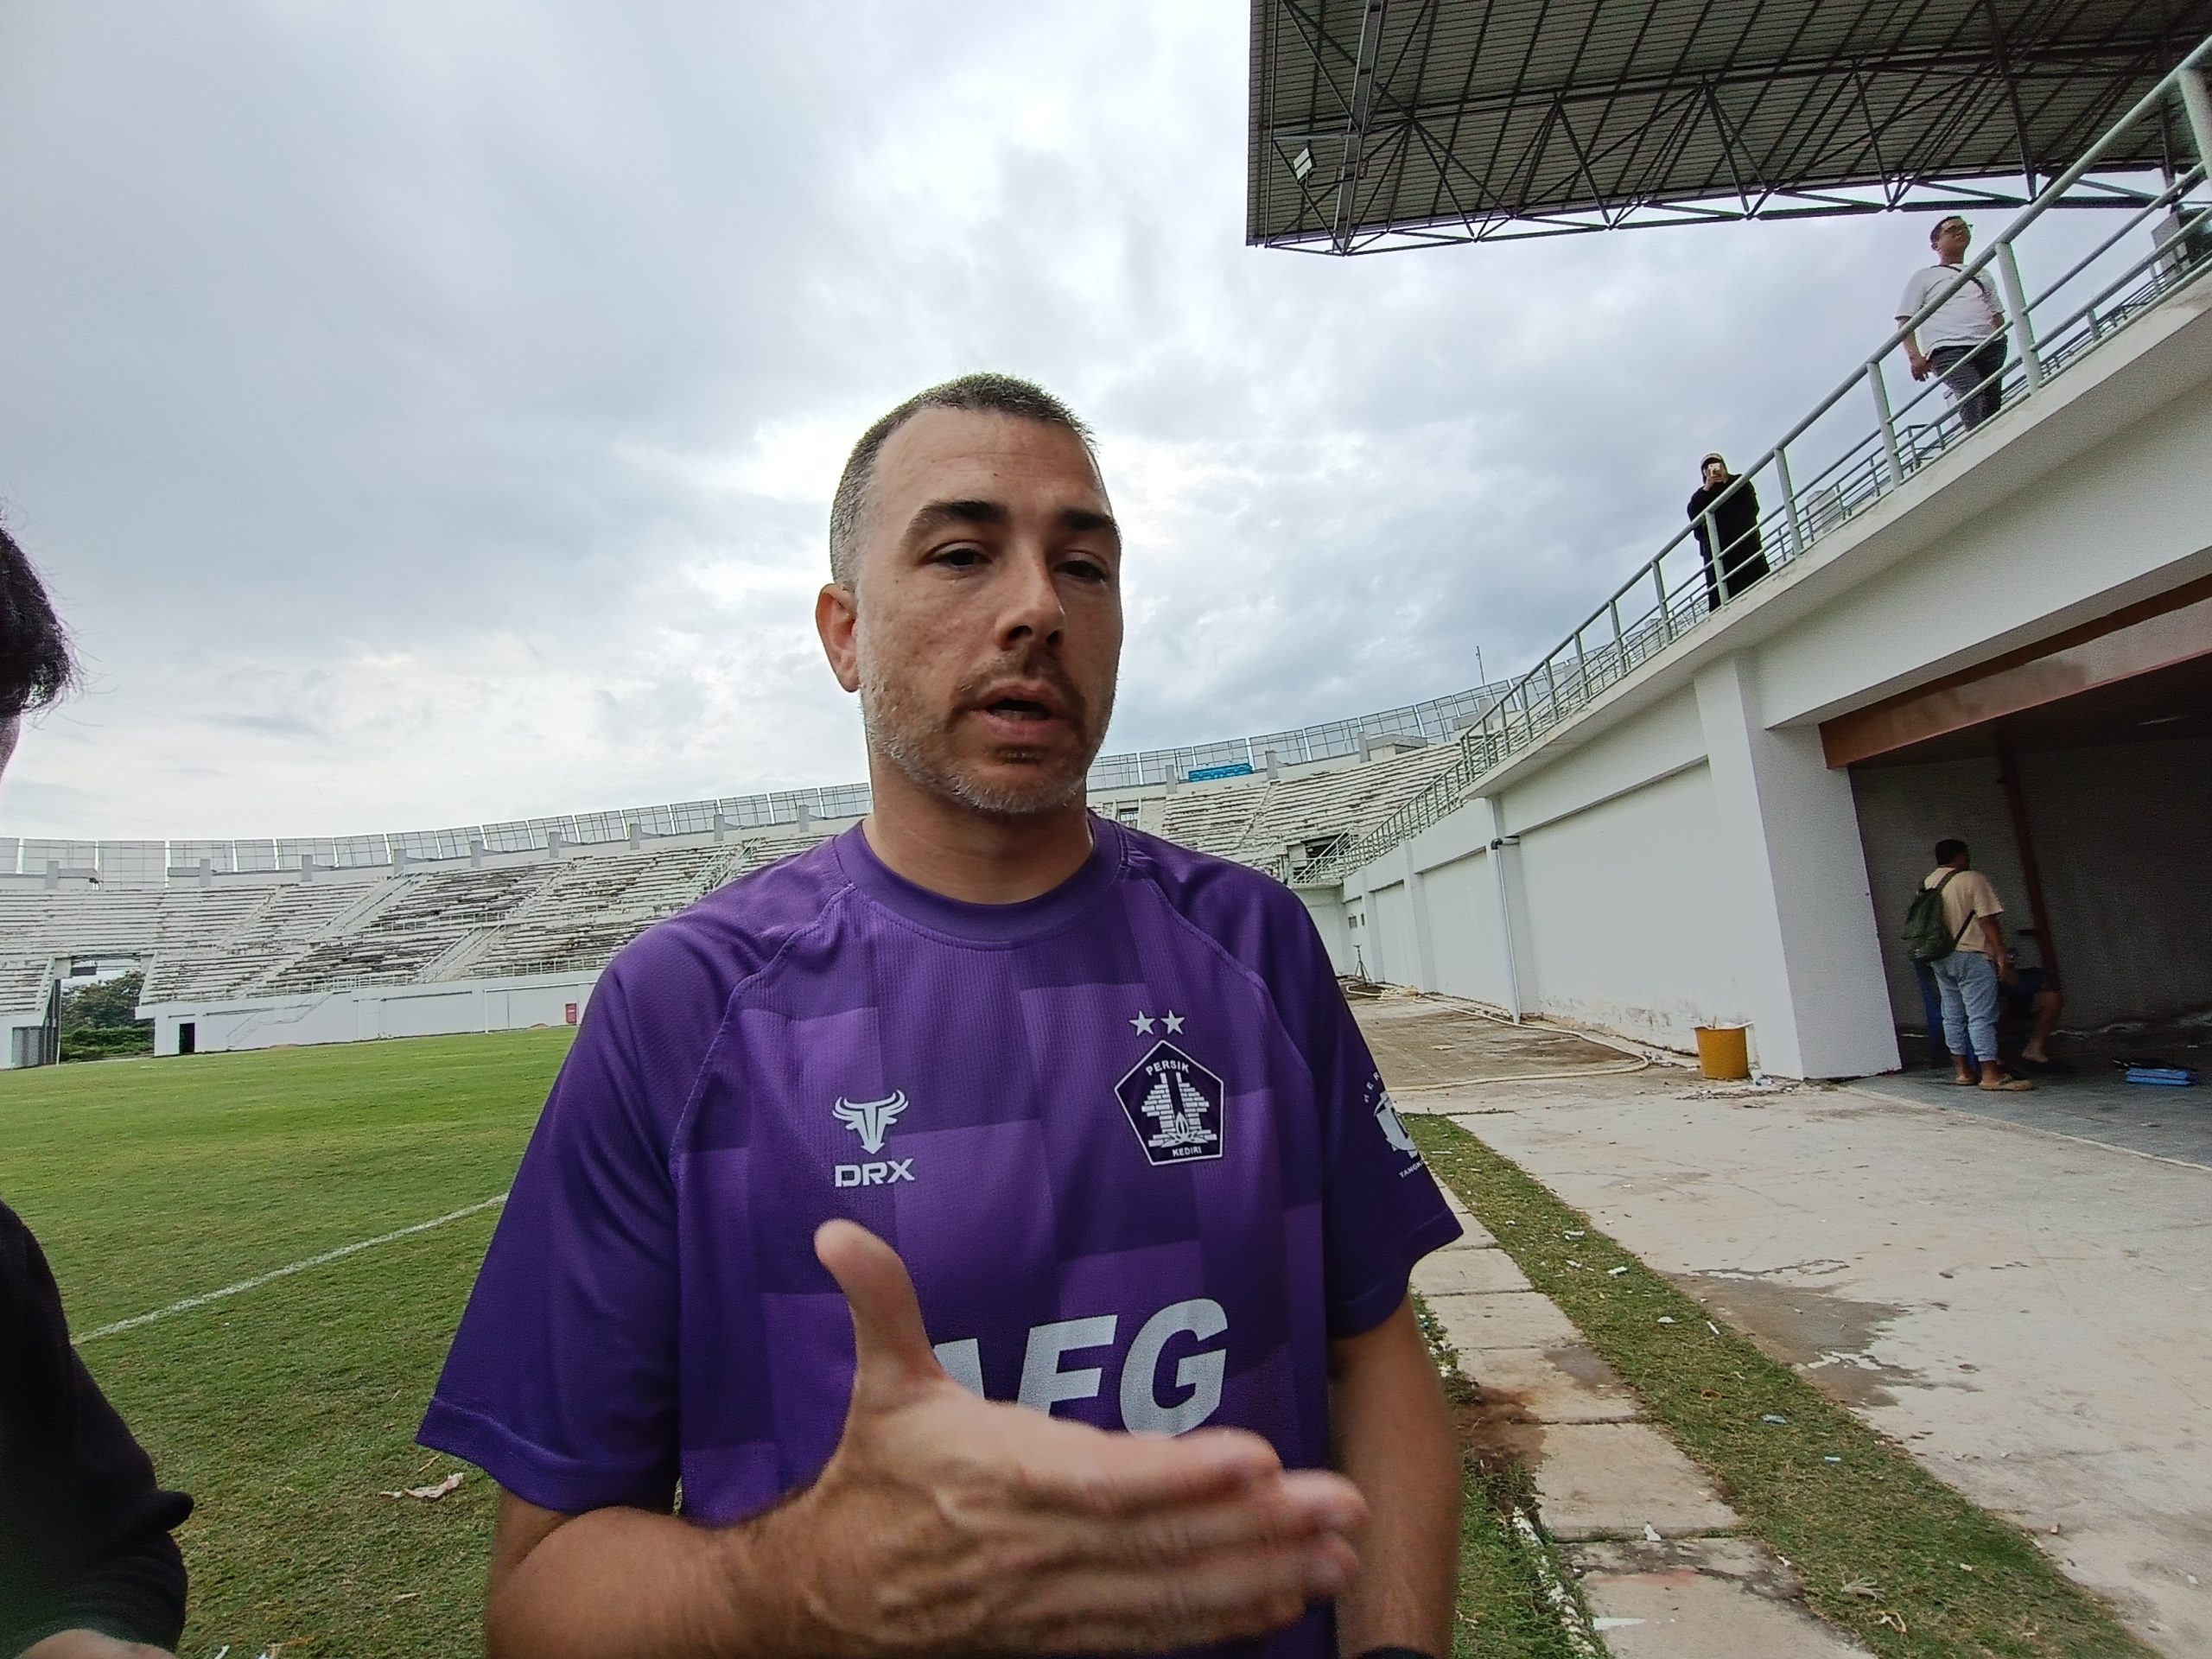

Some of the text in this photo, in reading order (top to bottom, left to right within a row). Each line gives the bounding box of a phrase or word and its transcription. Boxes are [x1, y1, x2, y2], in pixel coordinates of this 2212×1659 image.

[1145, 1060, 1190, 1076] PERSIK
[1172, 1146, 1202, 1157] KEDIRI
[835, 1158, 915, 1187] DRX
